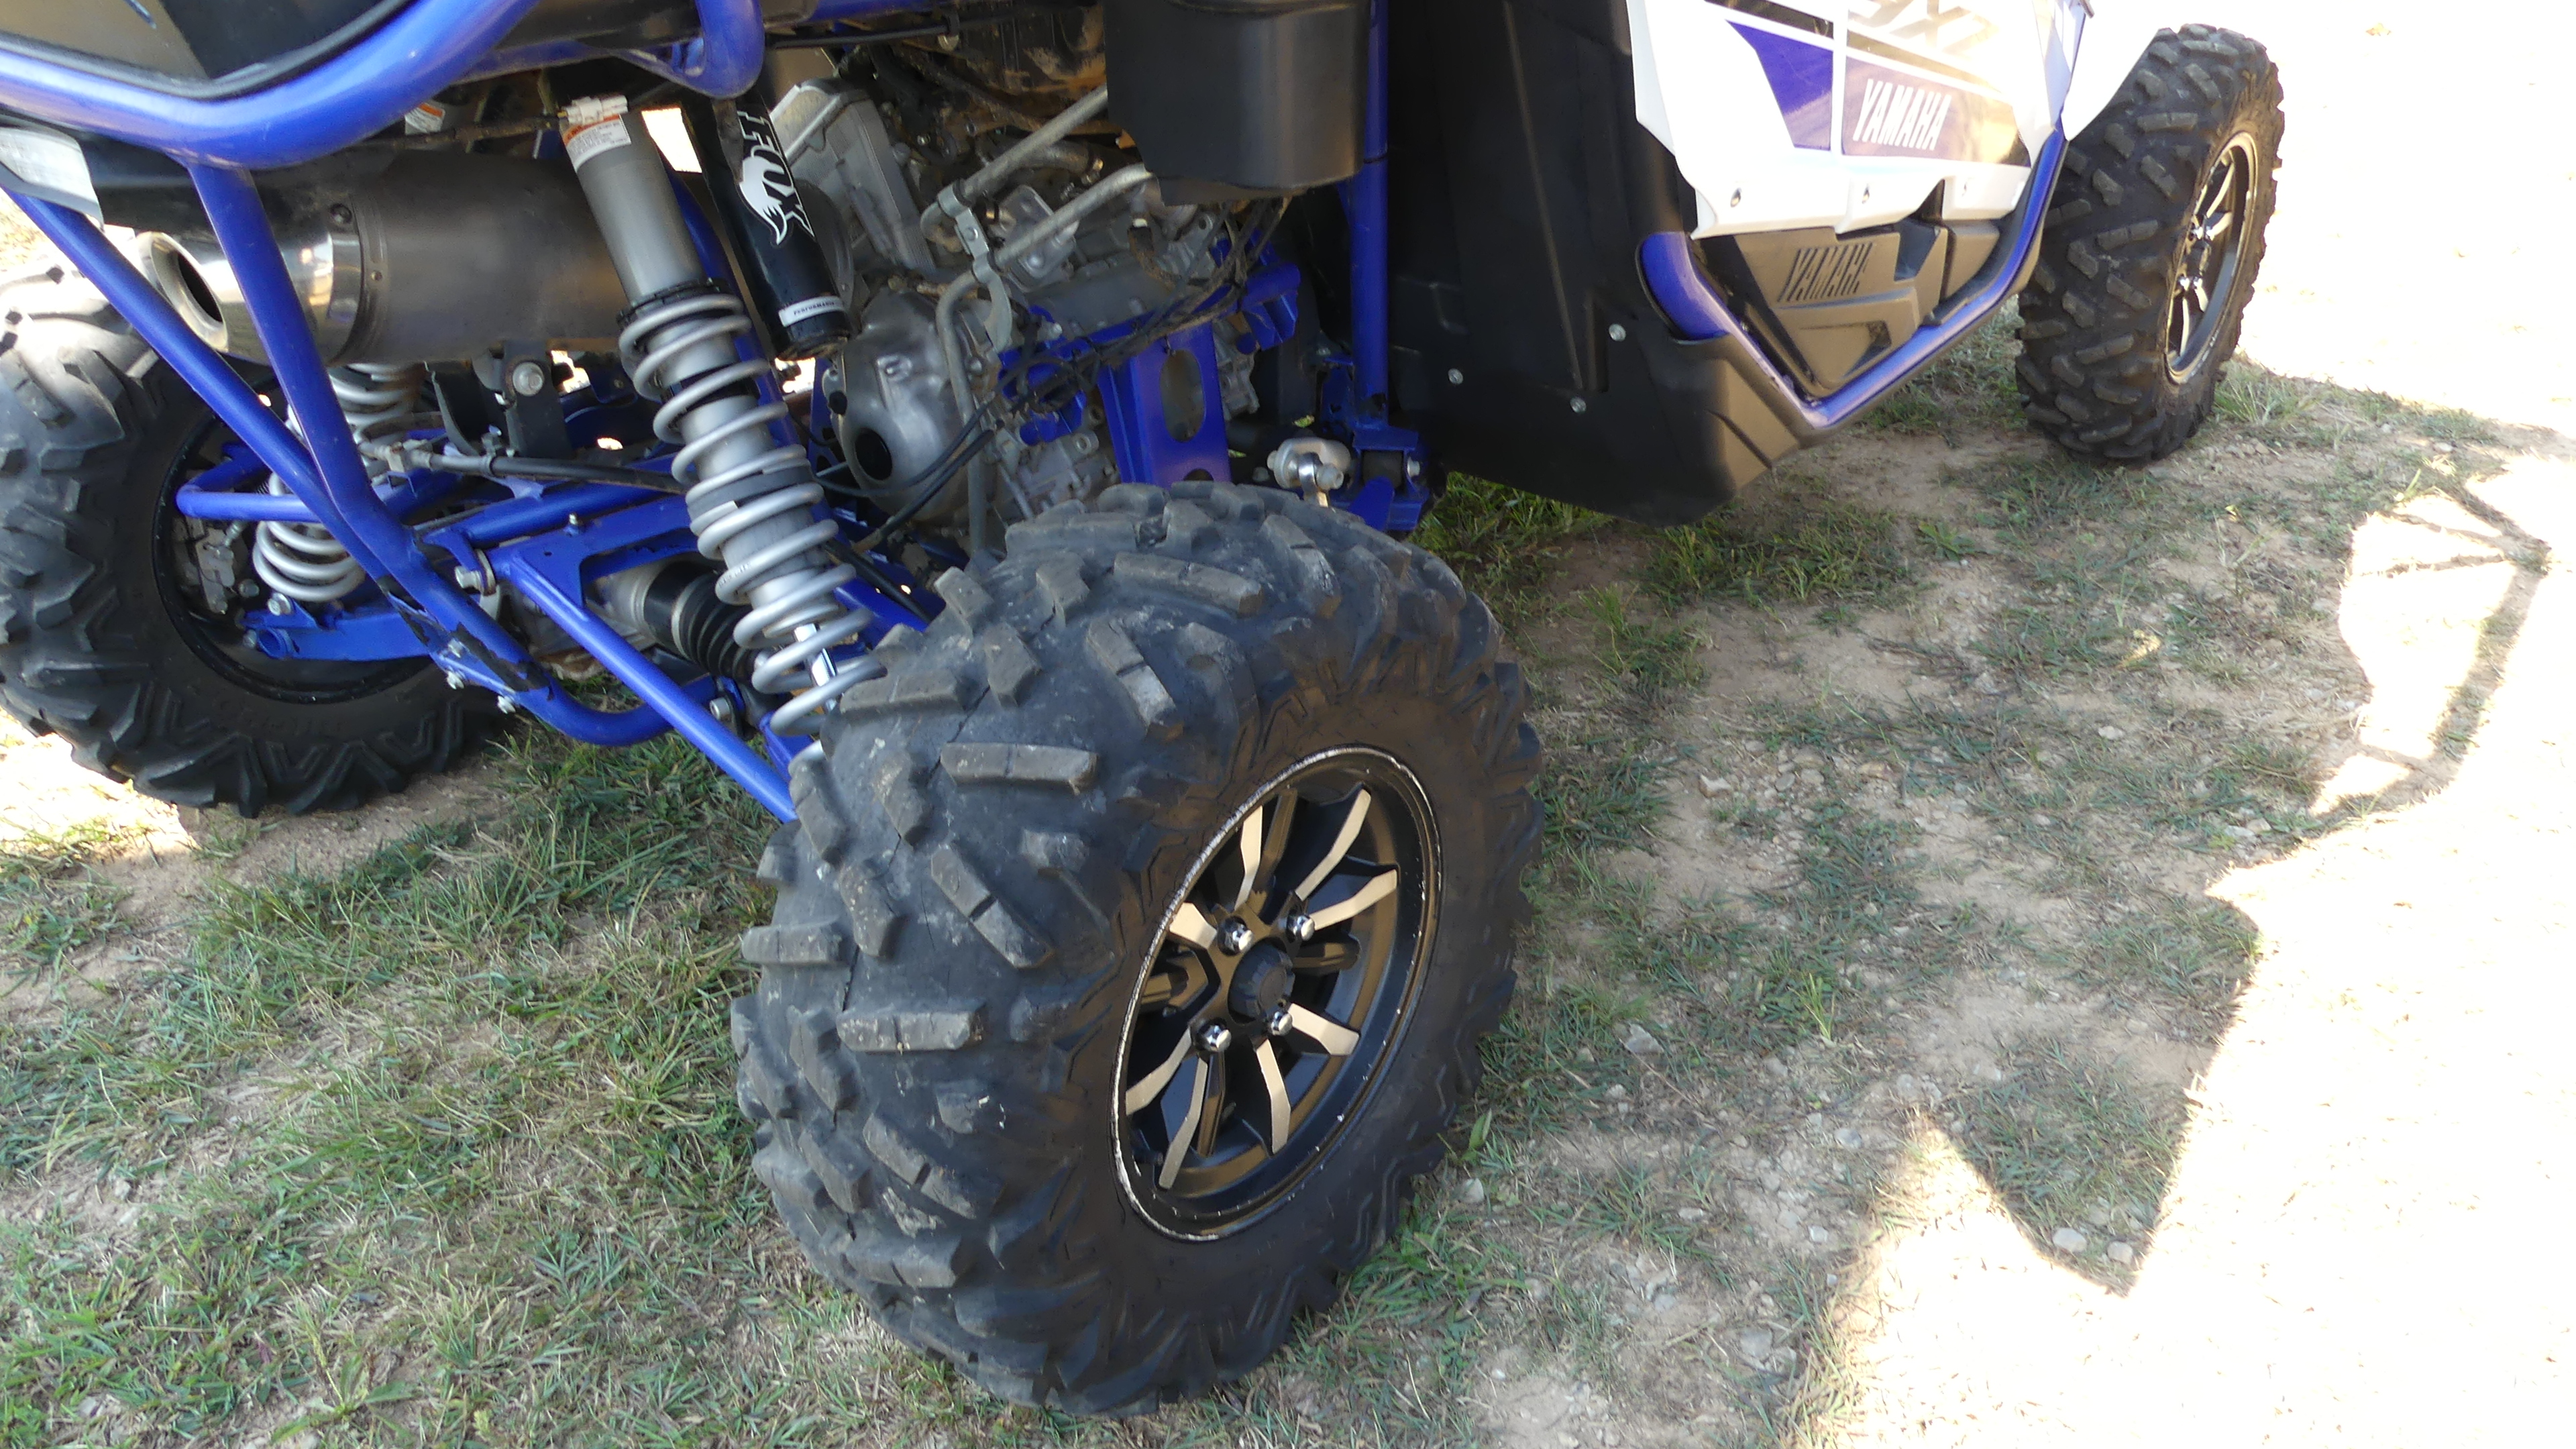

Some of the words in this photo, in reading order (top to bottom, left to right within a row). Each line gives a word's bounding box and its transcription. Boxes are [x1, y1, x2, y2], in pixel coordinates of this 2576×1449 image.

[1853, 78, 1952, 151] YAMAHA
[737, 111, 814, 237] FOX
[1777, 242, 1876, 302] YAMAHA
